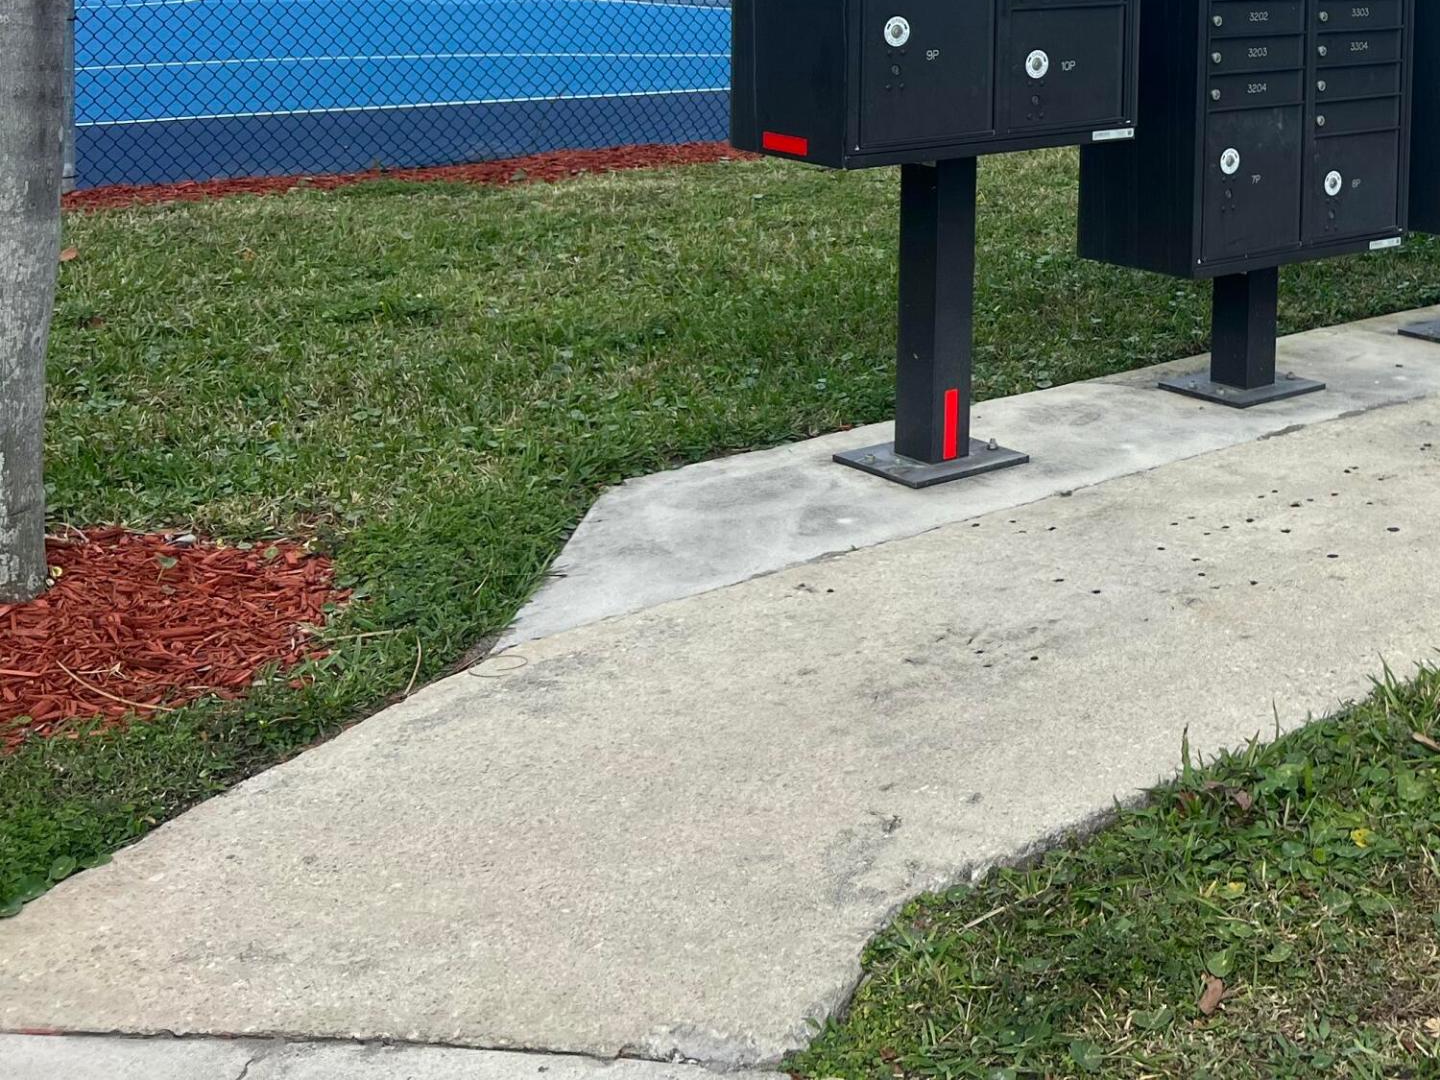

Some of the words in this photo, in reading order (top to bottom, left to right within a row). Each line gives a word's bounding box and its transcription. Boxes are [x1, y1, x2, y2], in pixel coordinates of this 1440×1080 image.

[1248, 10, 1269, 22] 3202
[1351, 7, 1370, 18] 3303
[1247, 46, 1268, 58] 3203
[1349, 40, 1369, 52] 3304
[925, 49, 940, 61] 9P
[1060, 60, 1076, 72] 10P
[1247, 82, 1267, 94] 3204
[1251, 174, 1262, 185] 7P
